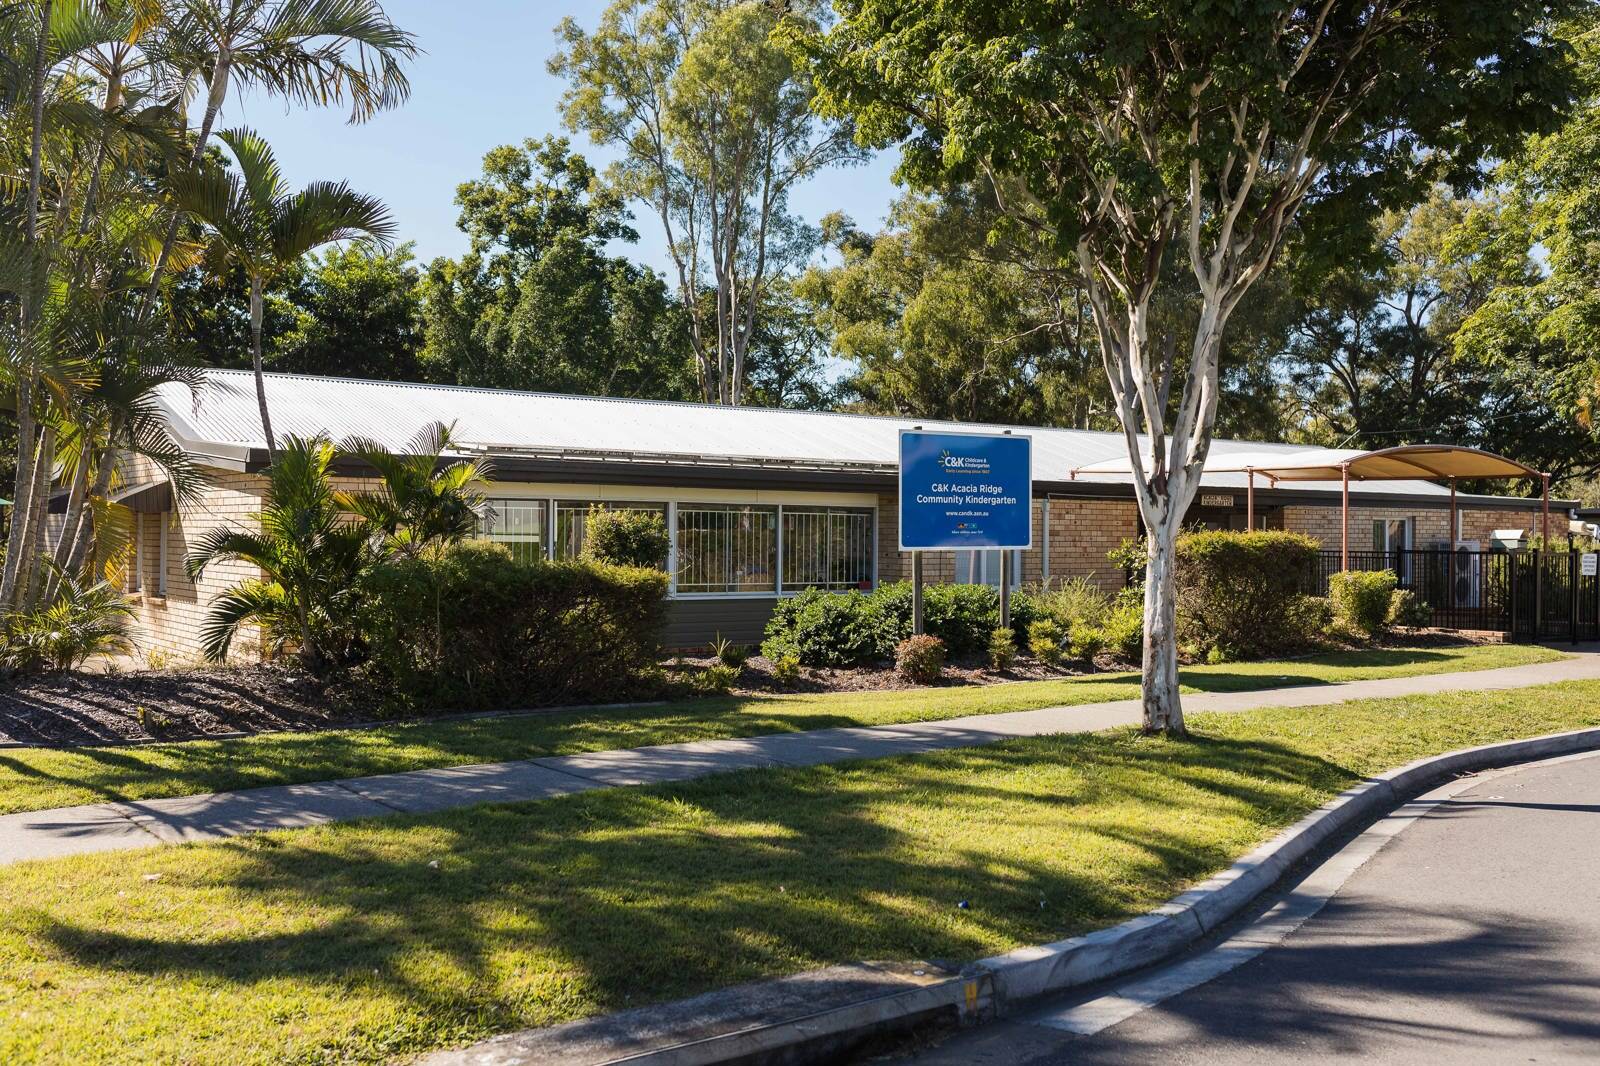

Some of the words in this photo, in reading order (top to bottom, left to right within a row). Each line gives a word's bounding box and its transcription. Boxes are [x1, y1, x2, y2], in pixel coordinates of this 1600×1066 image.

[944, 456, 964, 467] C&K
[931, 483, 949, 492] C&K
[951, 484, 977, 493] Acacia
[980, 484, 1003, 494] Ridge
[916, 494, 964, 505] Community
[966, 496, 1017, 505] Kindergarten
